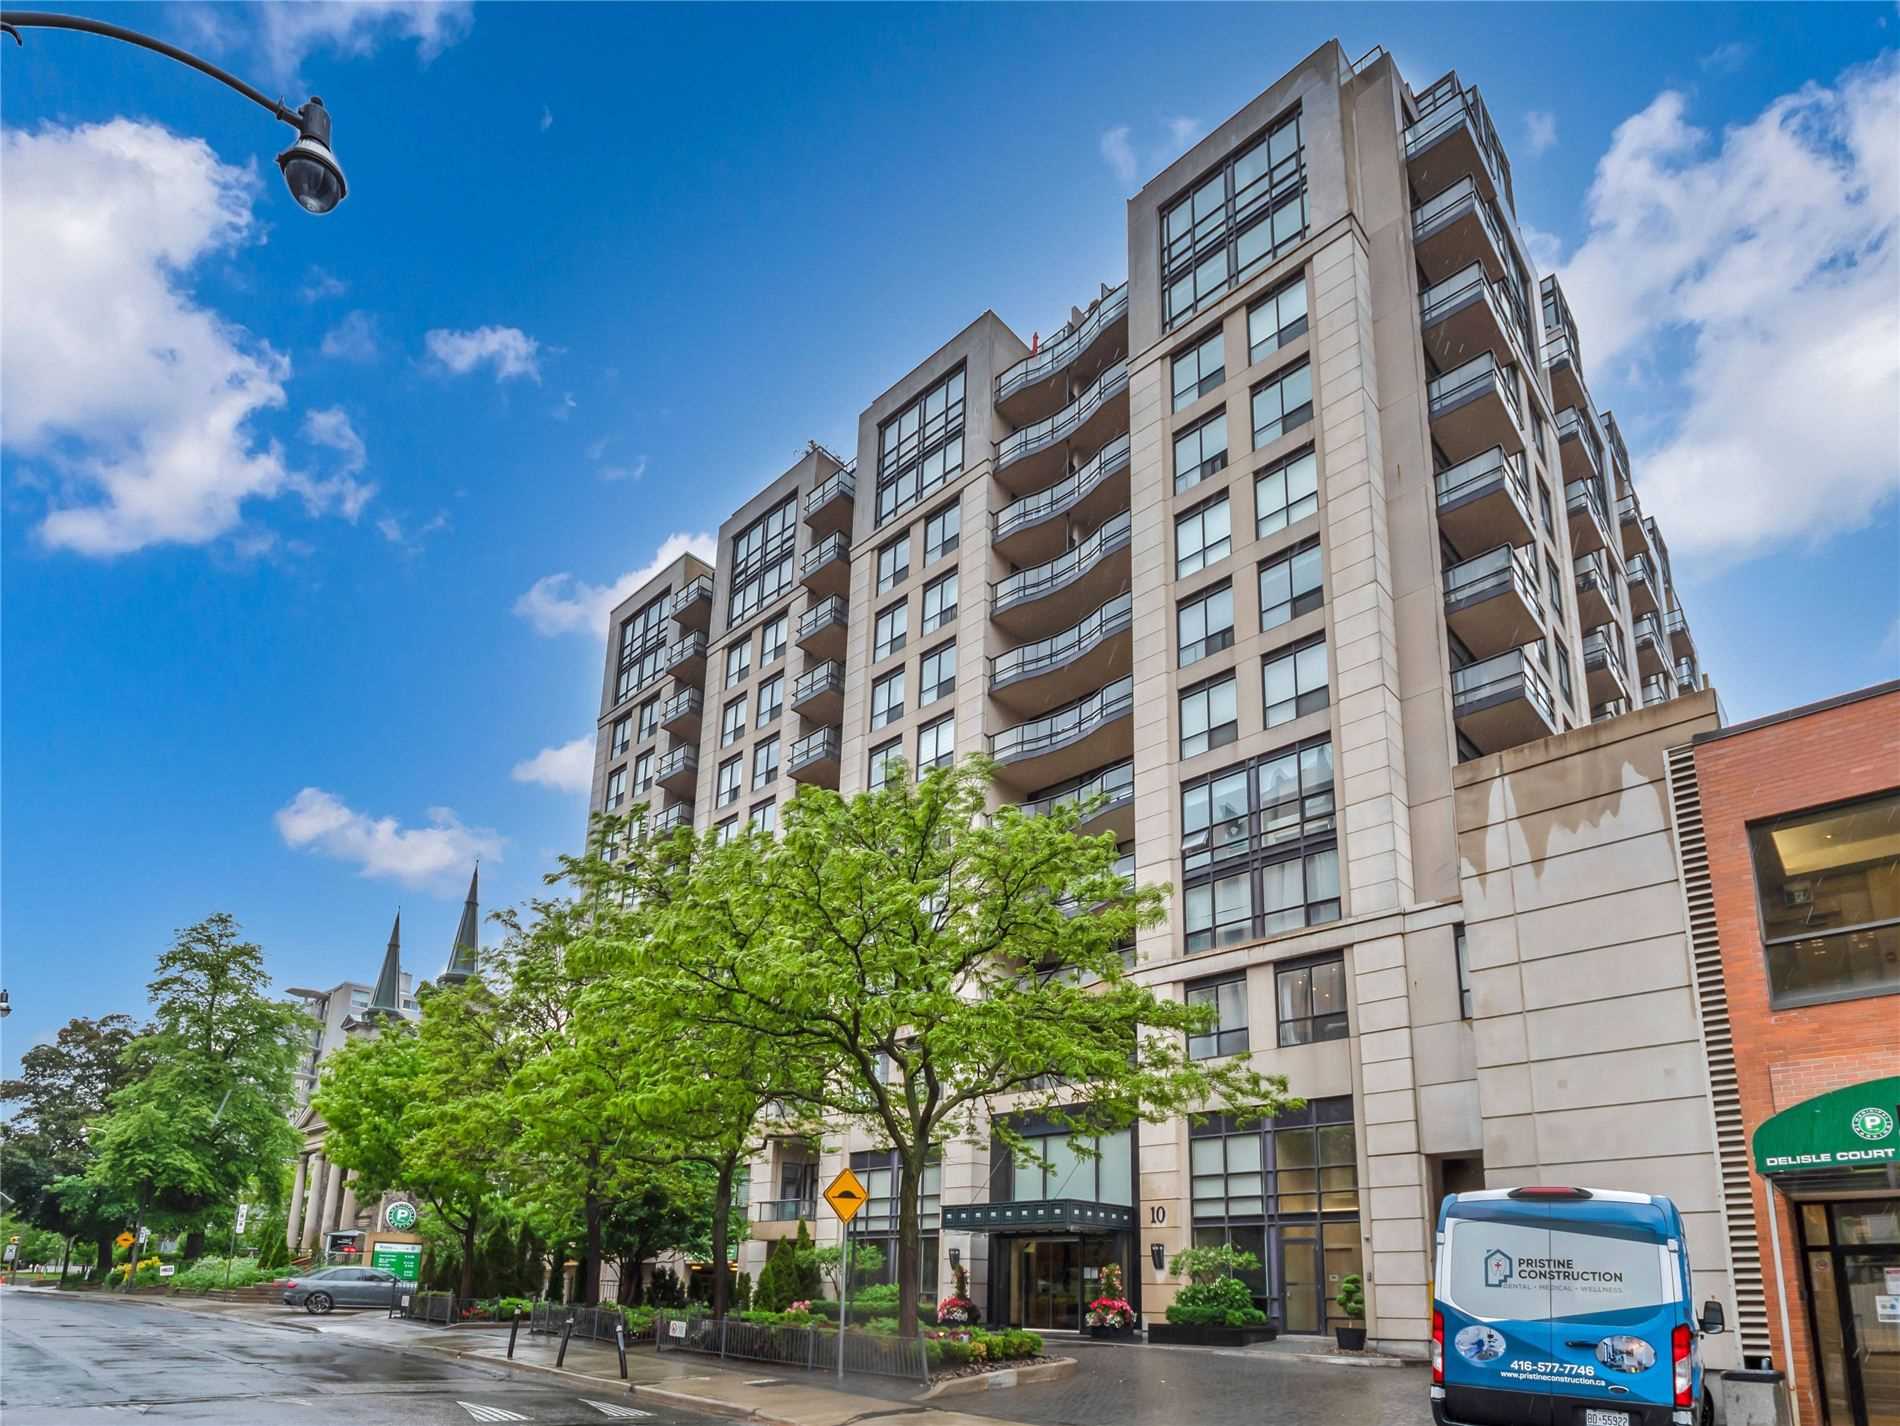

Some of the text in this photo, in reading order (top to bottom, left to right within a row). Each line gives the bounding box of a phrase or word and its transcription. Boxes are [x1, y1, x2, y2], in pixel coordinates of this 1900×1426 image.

[1766, 1148, 1895, 1166] DELISLE COURT
[1151, 1206, 1166, 1224] 10
[1518, 1258, 1574, 1269] PRISTINE
[1518, 1269, 1623, 1282] CONSTRUCTION
[1539, 1284, 1573, 1292] MEDICAL
[1510, 1360, 1595, 1376] 416-577-7746
[1500, 1370, 1606, 1386] www.pristineconstruction.ca
